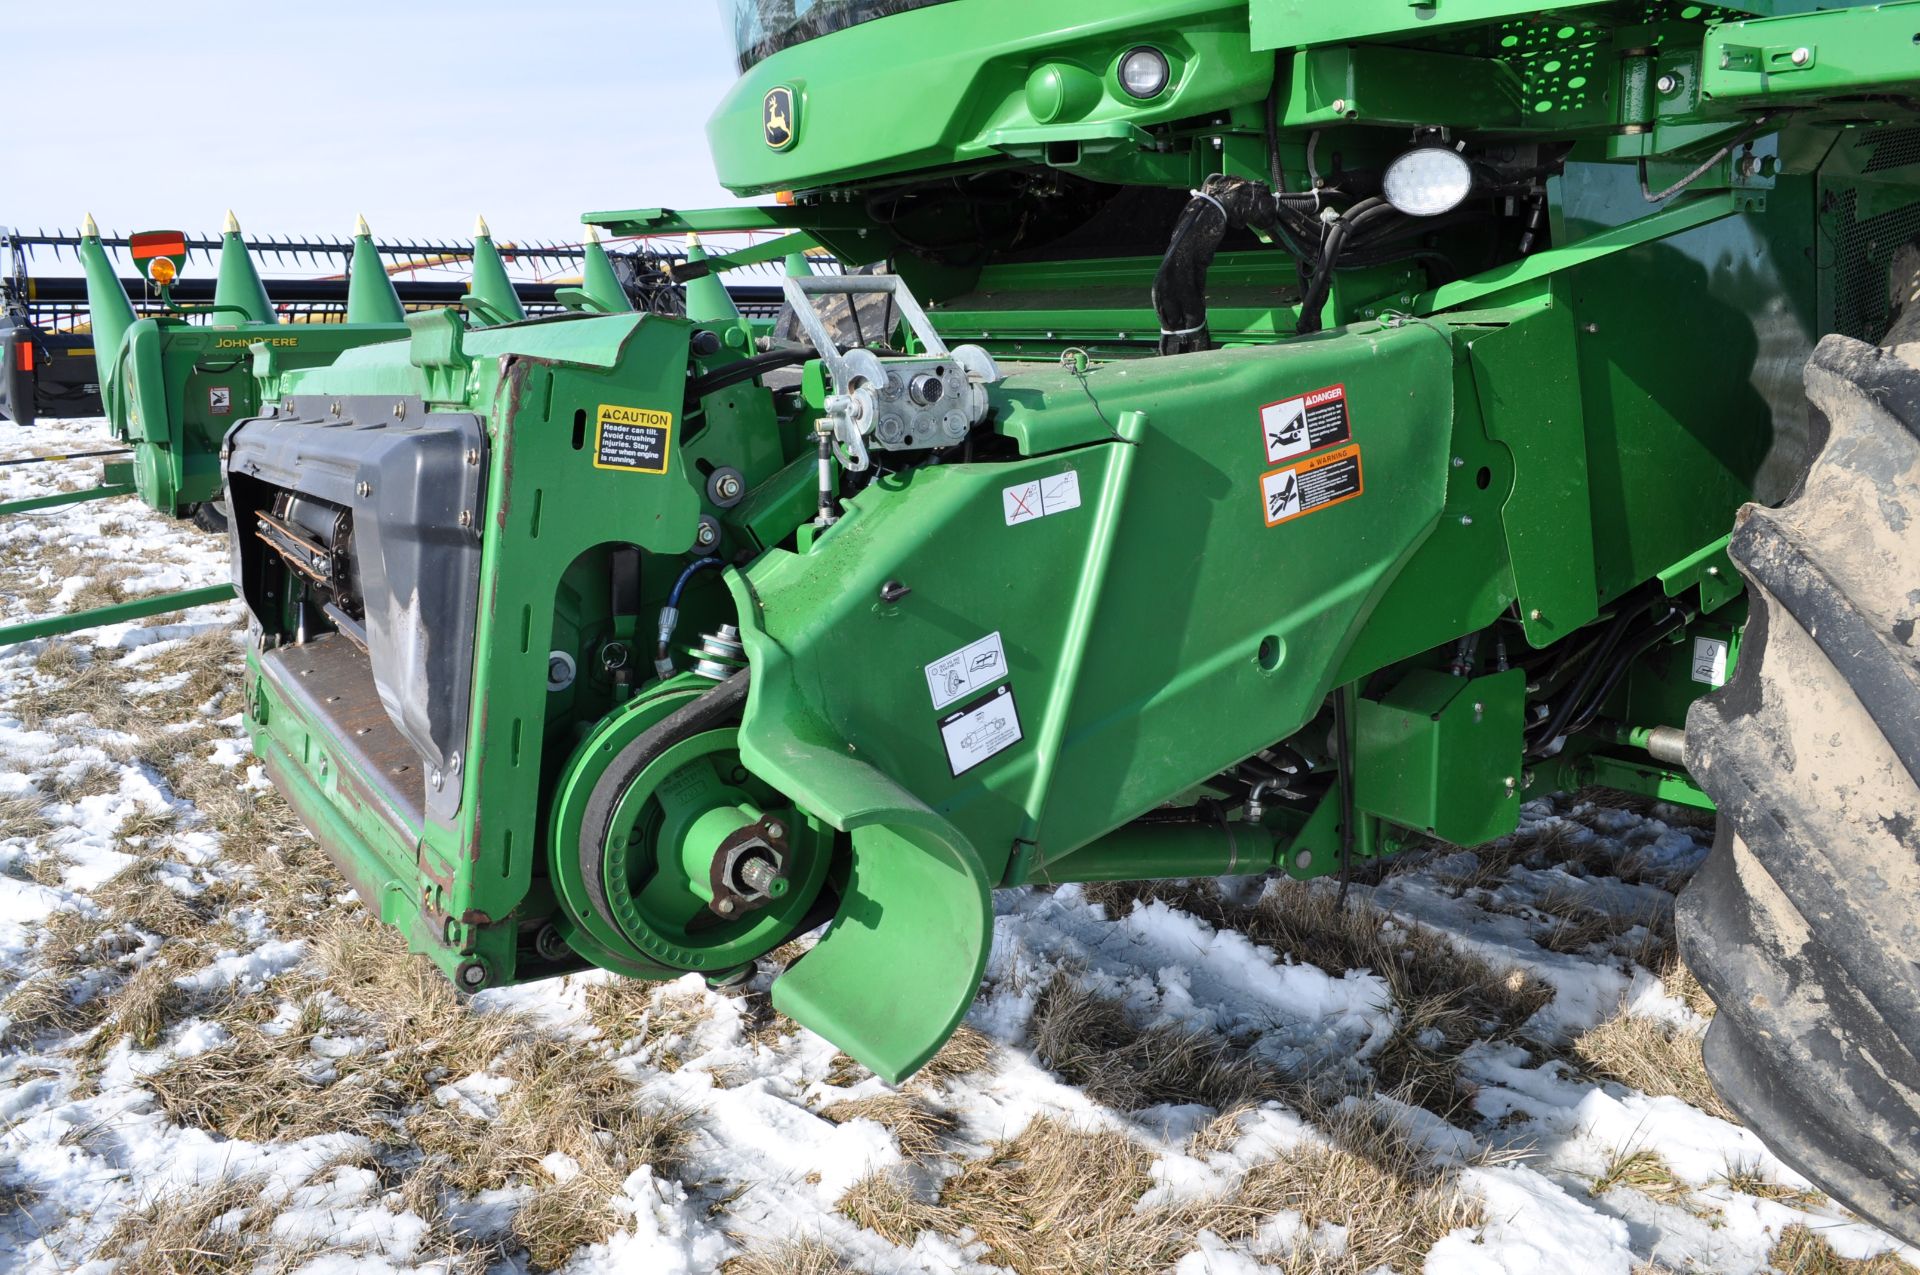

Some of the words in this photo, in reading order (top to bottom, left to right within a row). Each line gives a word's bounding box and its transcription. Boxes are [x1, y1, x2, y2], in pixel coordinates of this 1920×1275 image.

[216, 338, 251, 348] JOHN
[1312, 388, 1342, 403] DANGER
[612, 410, 668, 425] CAUTION
[603, 423, 630, 432] Header
[602, 431, 624, 439] Avoid
[625, 434, 656, 445] crushing
[602, 439, 631, 448] injuries.
[633, 442, 649, 451] Stay
[608, 456, 637, 465] running.
[637, 451, 659, 460] engine
[1317, 450, 1347, 465] WARNING
